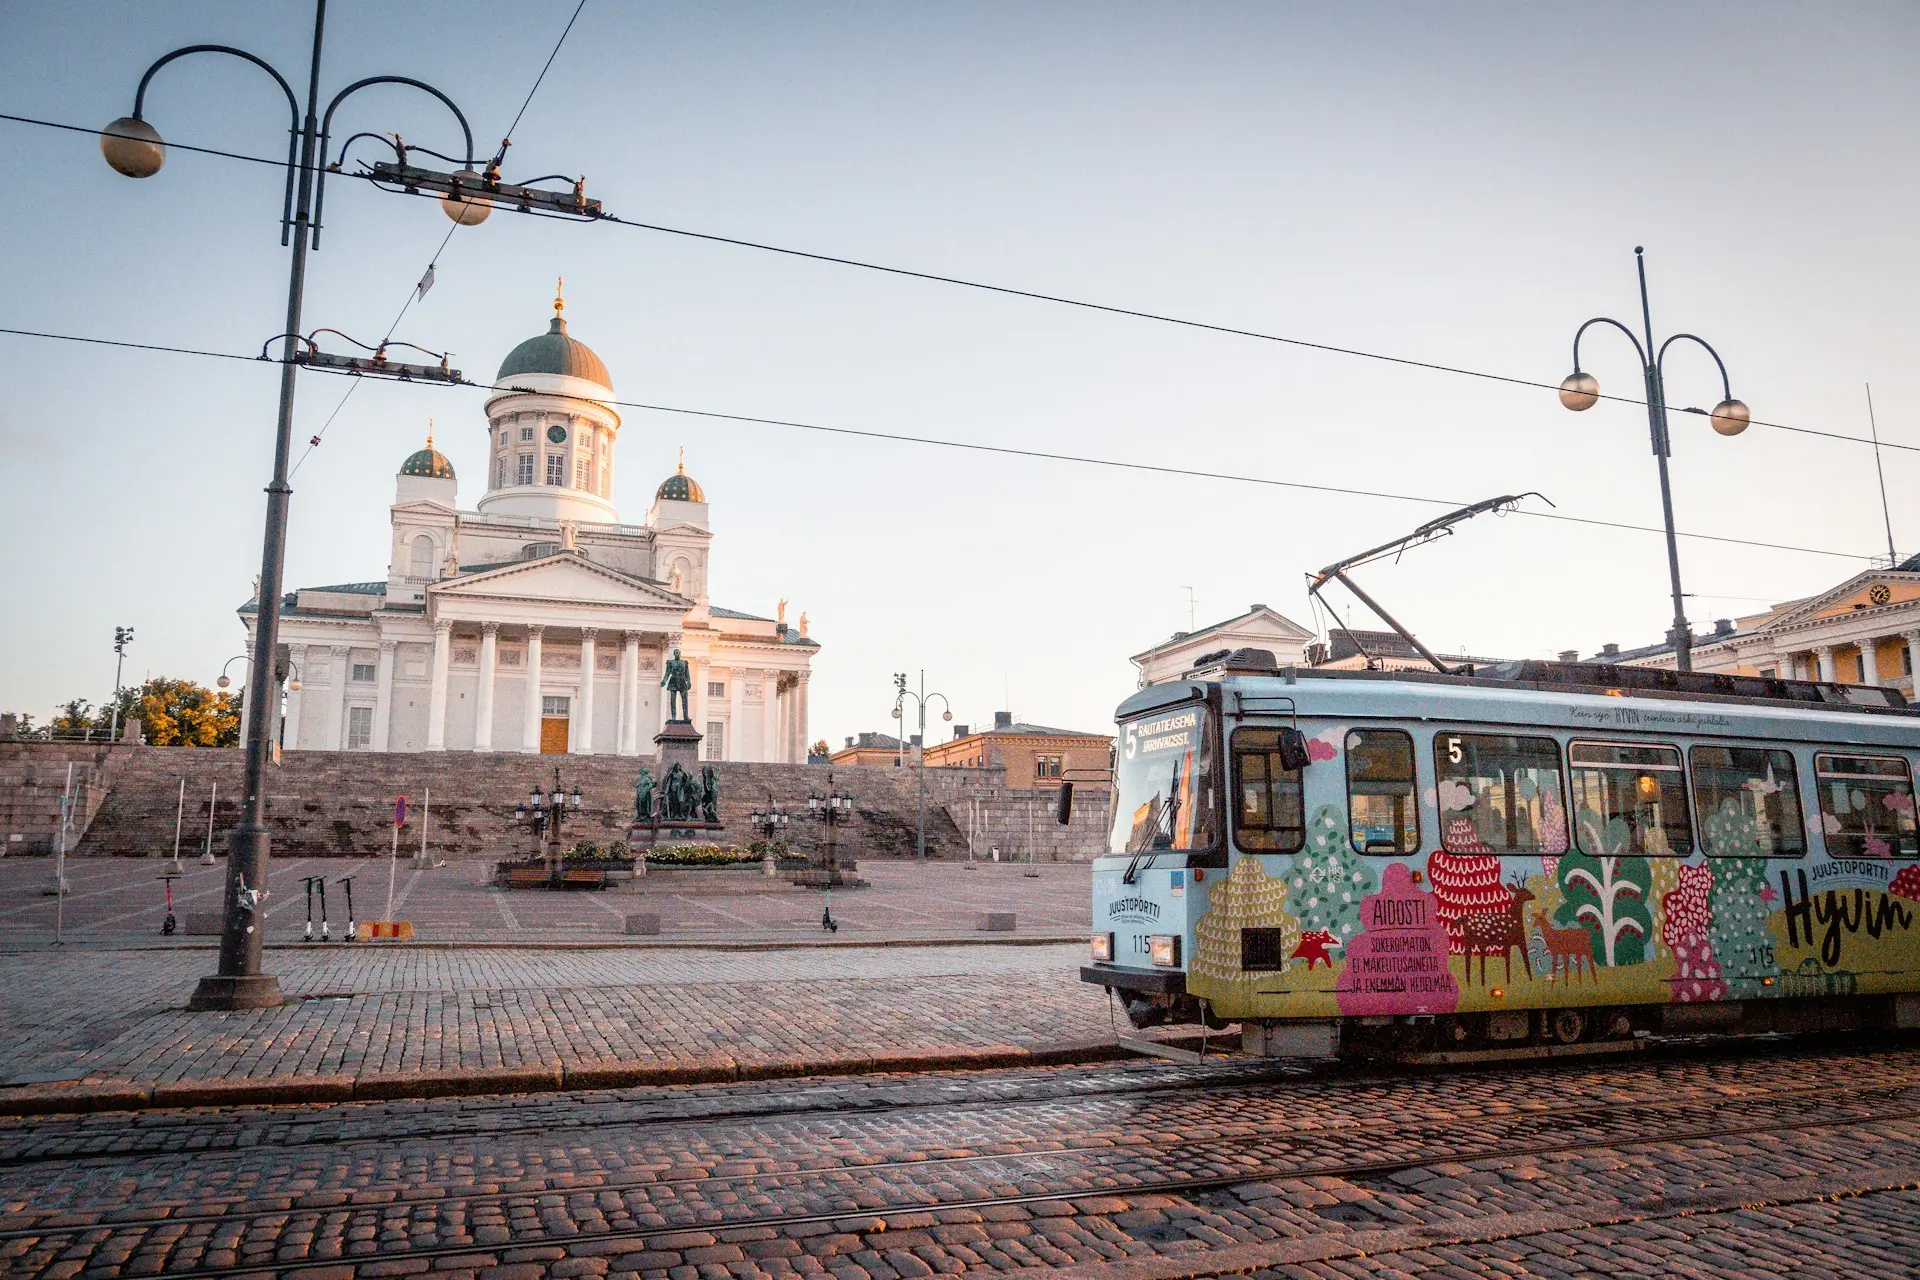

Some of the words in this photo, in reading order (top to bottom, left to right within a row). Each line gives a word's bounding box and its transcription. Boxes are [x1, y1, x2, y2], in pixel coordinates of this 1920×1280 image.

[1126, 722, 1138, 759] 5
[1138, 713, 1196, 737] RAUTATIEASEMA
[1448, 737, 1462, 764] 5
[1812, 860, 1888, 881] JUUSTOPORTTI
[1109, 898, 1161, 919] JUUSTOPORTTI
[1373, 899, 1426, 926] AIDOSTI
[1780, 868, 1912, 967] Hyvin
[1133, 935, 1151, 954] 115
[1352, 958, 1360, 974] EI
[1363, 956, 1439, 973] MAKEUTUSAINEITA
[1750, 946, 1774, 969] 115
